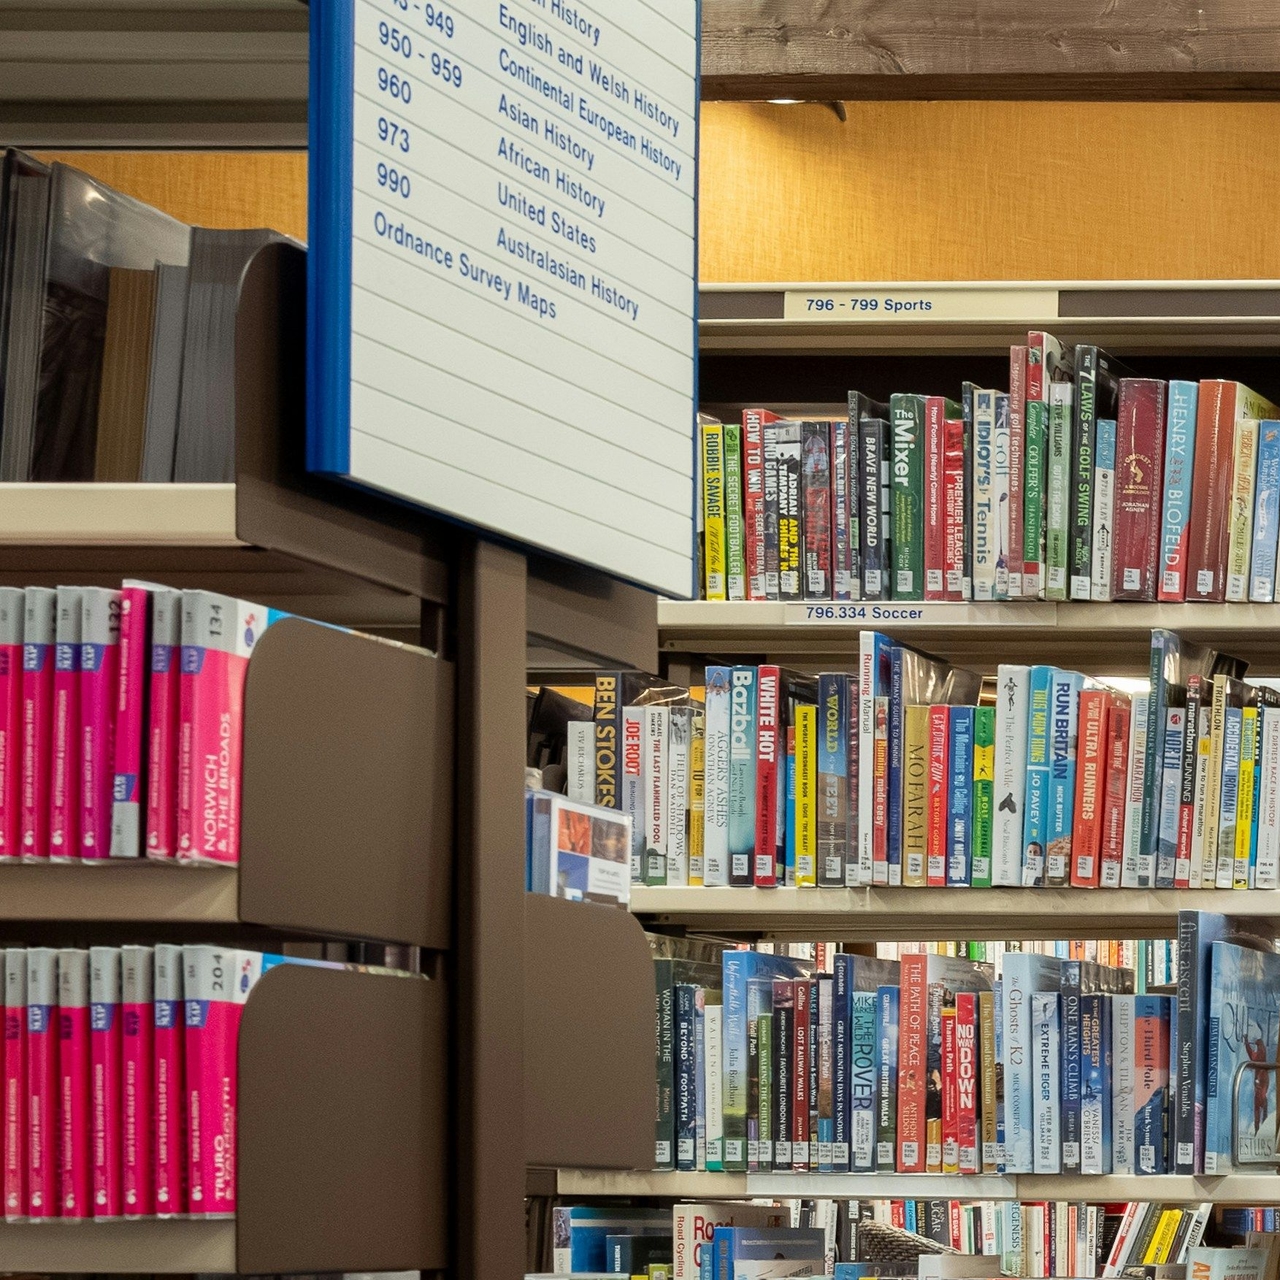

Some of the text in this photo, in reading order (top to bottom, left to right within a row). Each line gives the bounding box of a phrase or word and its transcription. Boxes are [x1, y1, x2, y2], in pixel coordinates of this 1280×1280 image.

[551, 0, 599, 45] History
[379, 22, 412, 58] 950
[431, 53, 462, 88] 959
[498, 94, 539, 135] Asian
[544, 118, 594, 171] History
[426, 5, 682, 180] 949 Continental European History
[499, 8, 679, 137] English and Welsh History
[378, 68, 605, 218] 960 African History
[378, 118, 596, 253] 973 United States
[374, 212, 557, 319] Ordnance Survey Maps
[377, 163, 639, 321] 990 Australasian History
[807, 299, 834, 311] 796
[851, 299, 878, 311] 799
[884, 299, 932, 312] Sports
[895, 410, 913, 418] The
[895, 420, 915, 486] Mixer
[1171, 395, 1188, 456] HENRY
[706, 433, 720, 520] ROBBIE SAVAGE
[1164, 488, 1182, 566] BLOFELD
[209, 604, 222, 637] 134
[807, 607, 922, 619] 796.334 Soccer
[596, 677, 615, 808] BEN STOKES
[732, 671, 752, 759] Bazball
[760, 676, 775, 762] WHITE HOT
[1053, 683, 1070, 780] RUN BRITAIN
[204, 755, 218, 851] NORWICH
[219, 712, 230, 828] THE BROADS
[212, 954, 222, 990] 204
[1180, 921, 1197, 1013] first ascent
[957, 1024, 974, 1039] NO
[957, 1039, 974, 1048] WAY
[958, 1049, 974, 1108] DOWN
[214, 1136, 225, 1200] TRURO
